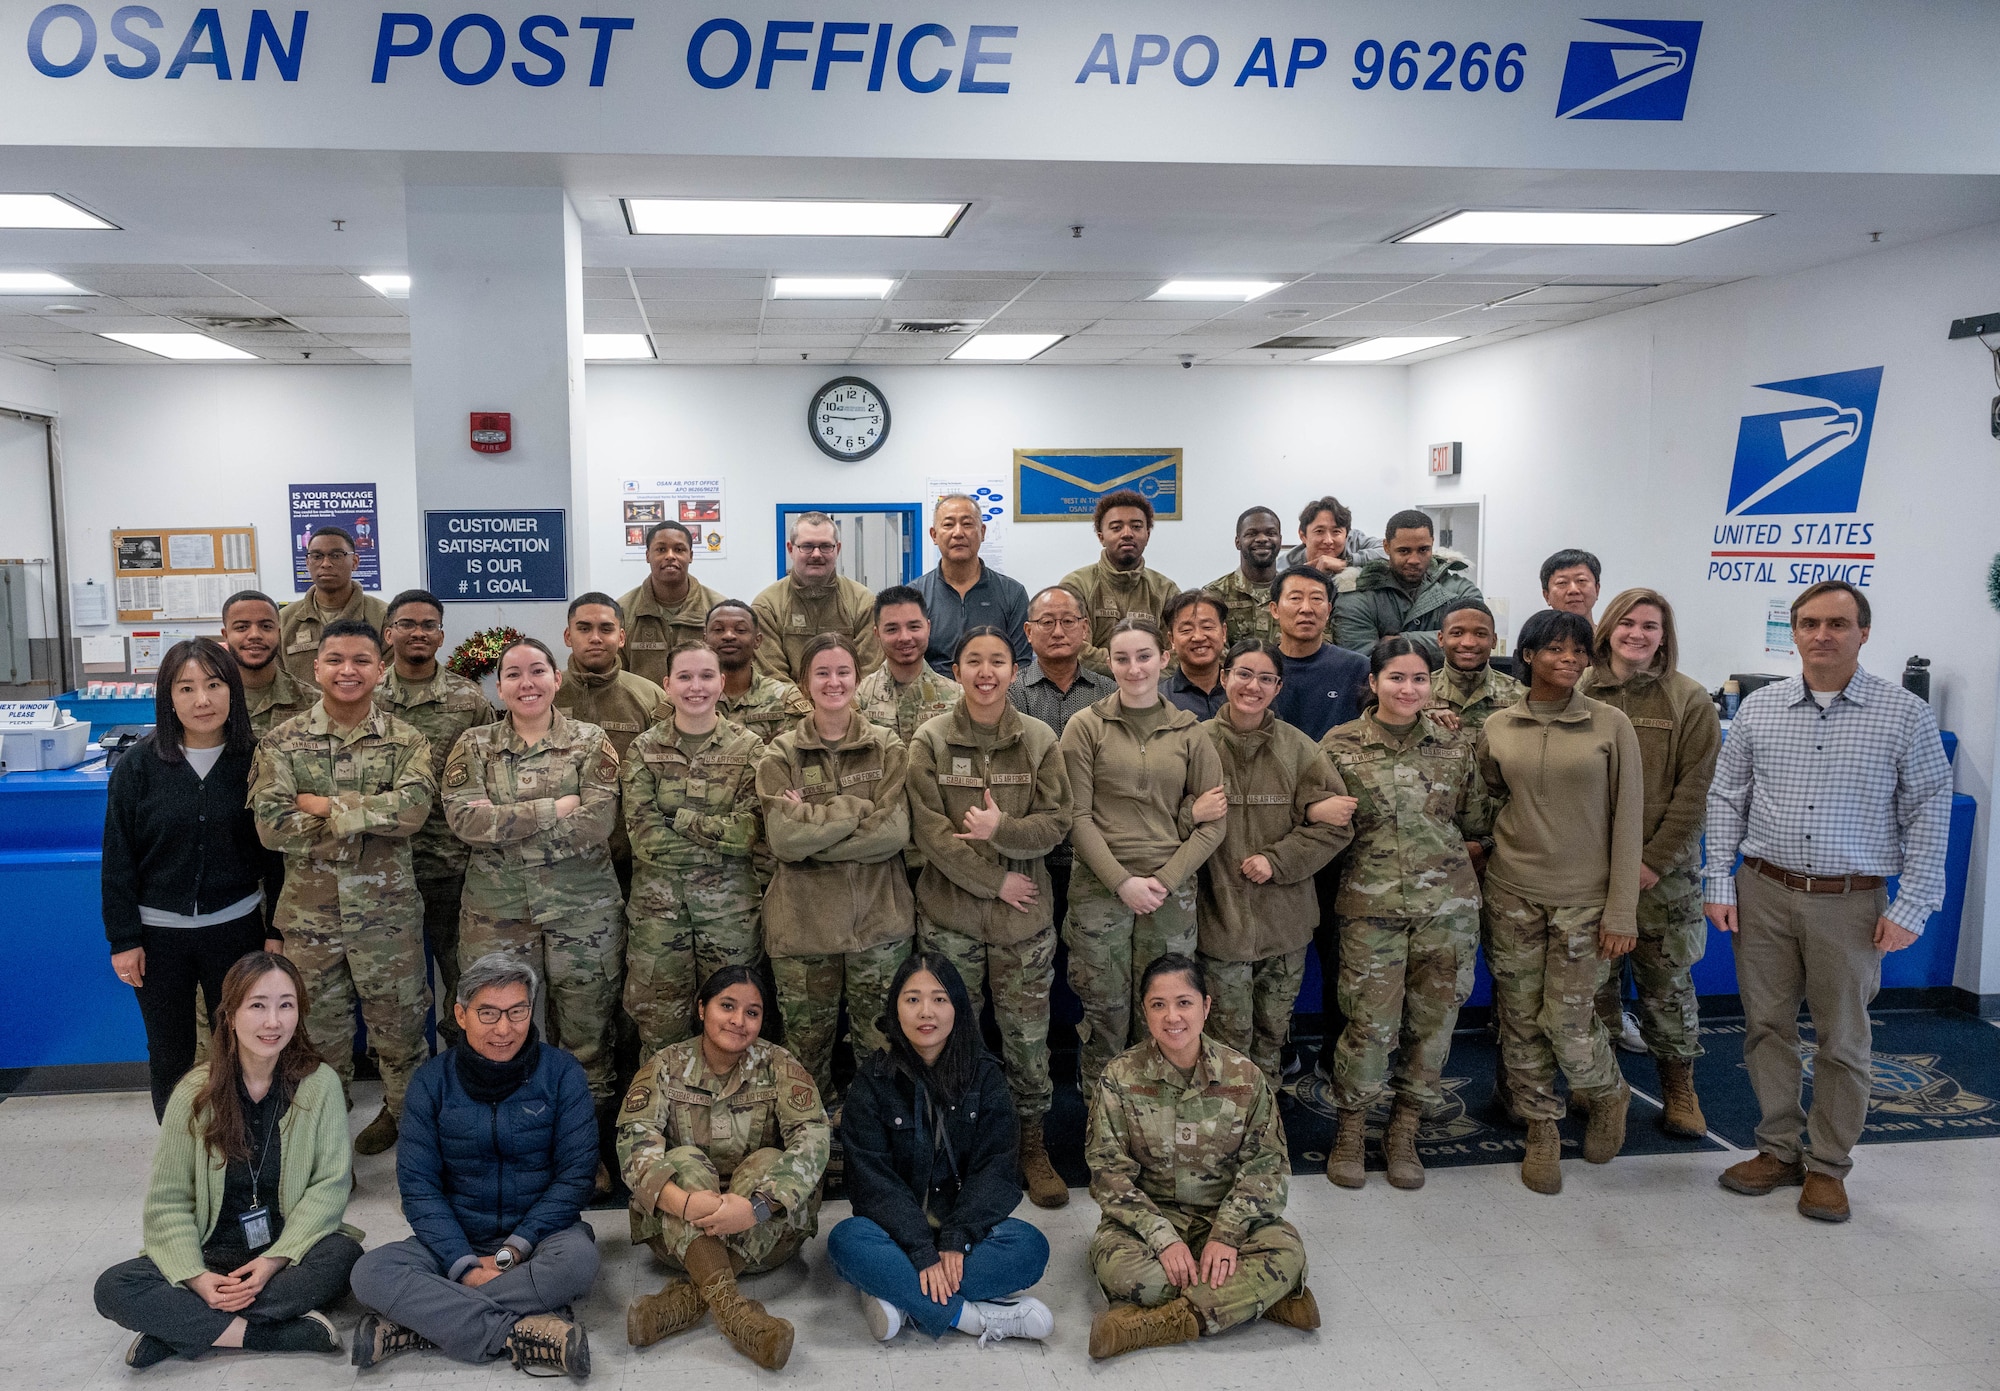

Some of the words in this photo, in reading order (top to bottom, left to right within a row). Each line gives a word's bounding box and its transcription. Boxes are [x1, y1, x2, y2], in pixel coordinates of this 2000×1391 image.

[26, 4, 309, 81] OSAN
[370, 12, 635, 87] POST
[687, 17, 1019, 94] OFFICE
[1075, 33, 1220, 87] APO
[1234, 37, 1327, 88] AP
[1352, 39, 1527, 93] 96266
[836, 394, 843, 402] 11
[847, 390, 856, 399] 12
[826, 403, 836, 411] 10
[868, 404, 874, 412] 2
[822, 414, 830, 423] 9
[872, 416, 878, 424] 3
[826, 427, 834, 435] 8
[835, 436, 842, 444] 7
[846, 439, 853, 447] 6
[858, 436, 865, 444] 5
[1432, 446, 1448, 472] EXIT
[293, 500, 320, 509] SAFE
[323, 500, 339, 509] TO
[341, 499, 373, 508] MAIL?
[448, 518, 537, 532] CUSTOMER
[1714, 524, 1781, 544] UNITED
[1792, 523, 1874, 545] STATES
[438, 538, 549, 553] SATISFACTION
[467, 559, 482, 573] IS
[487, 559, 522, 573] OUR
[1708, 562, 1776, 583] POSTAL
[1788, 563, 1874, 586] SERVICE
[458, 580, 468, 593] #
[473, 580, 480, 593] 1
[486, 579, 532, 593] GOAL
[1420, 1144, 1472, 1156] ost
